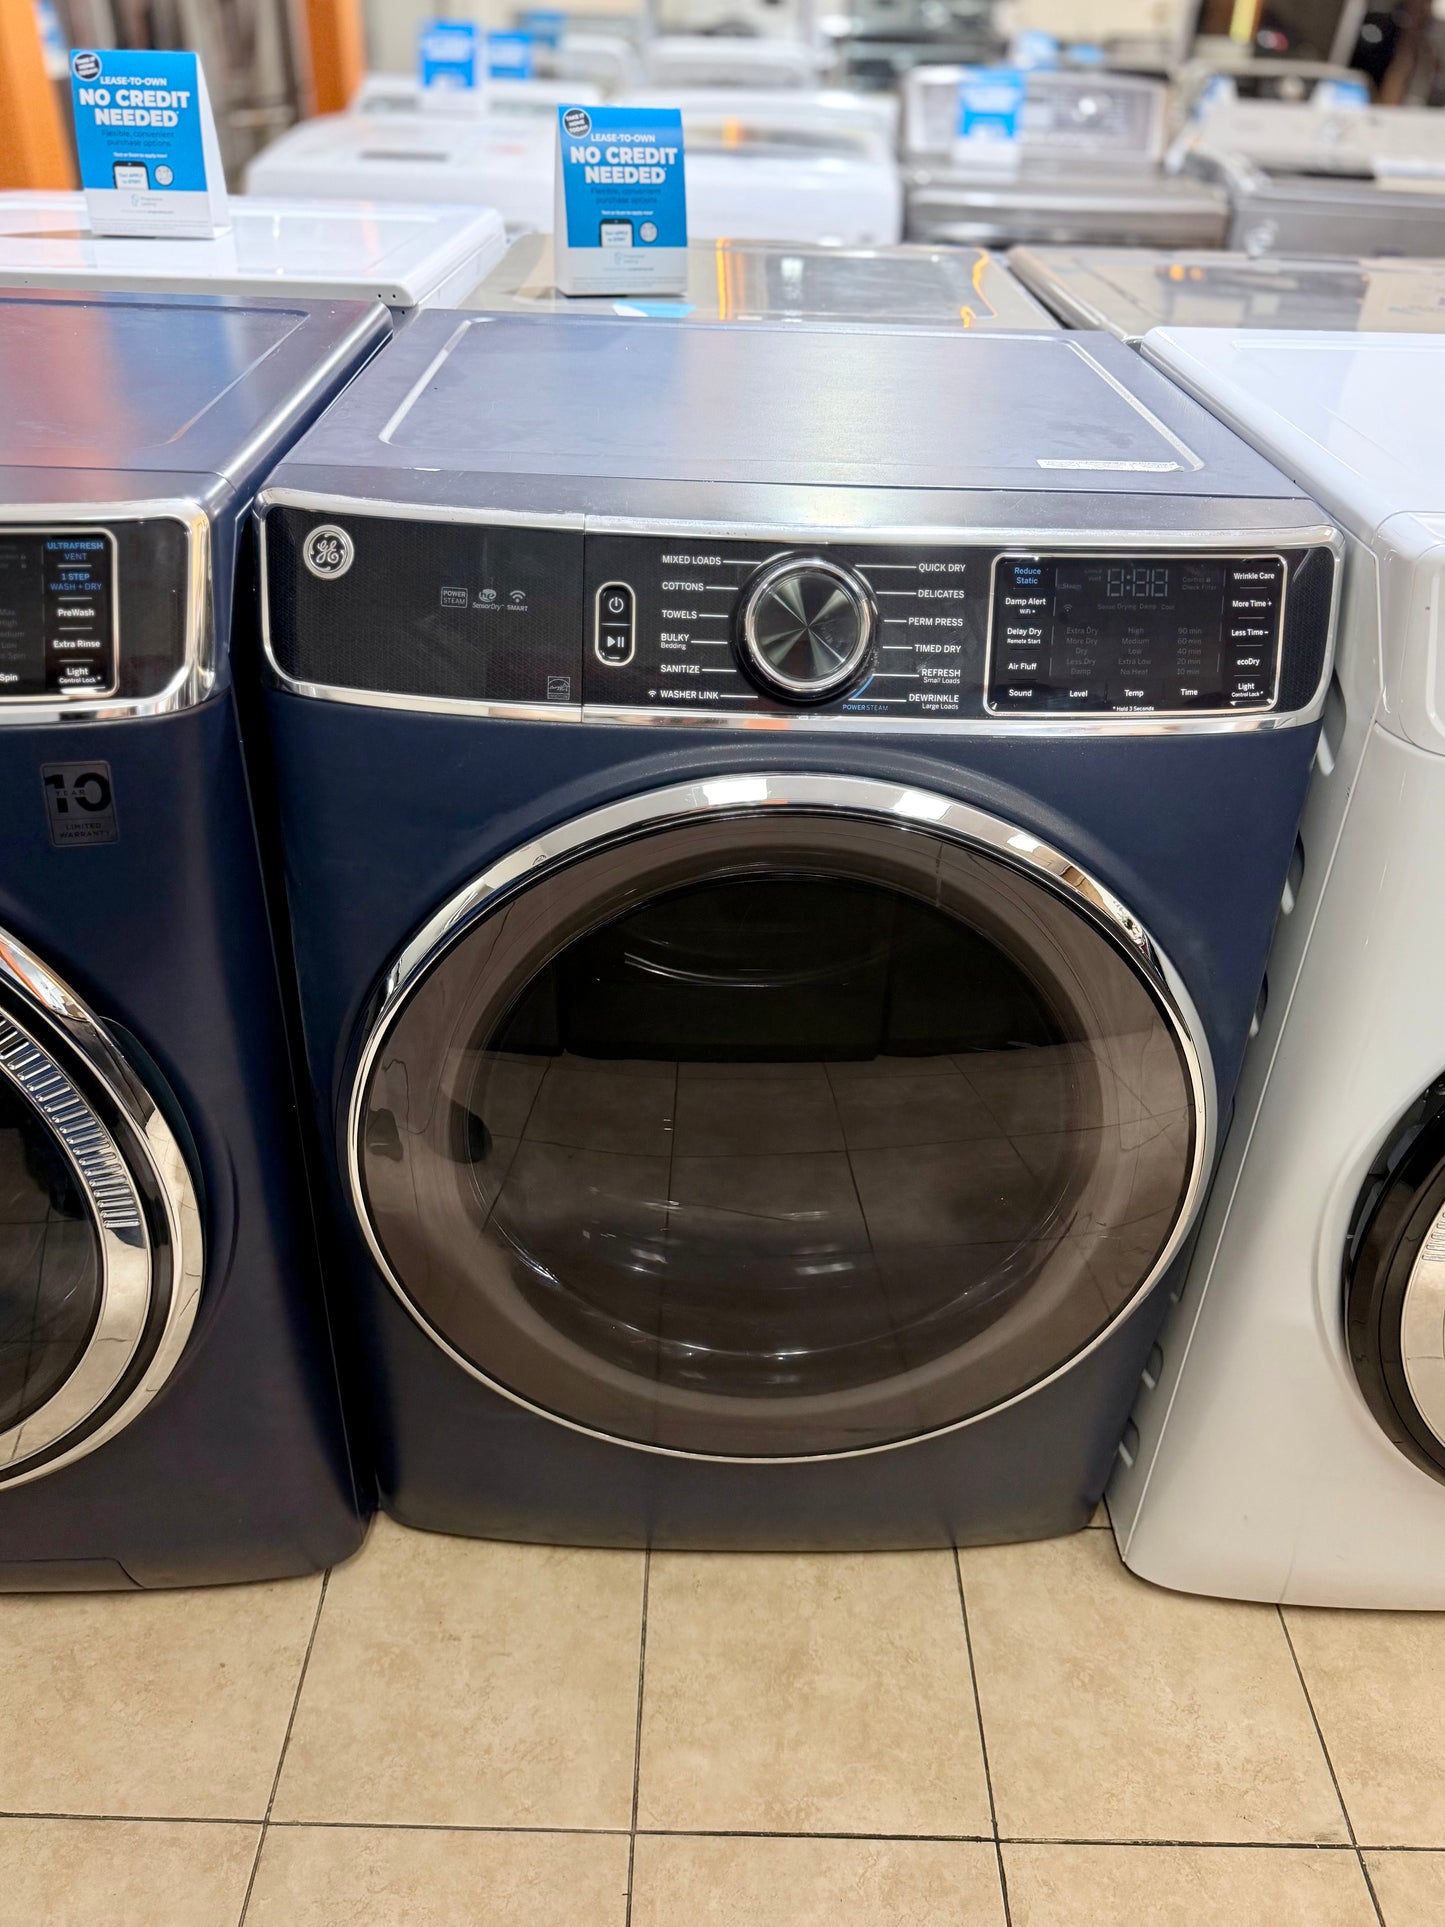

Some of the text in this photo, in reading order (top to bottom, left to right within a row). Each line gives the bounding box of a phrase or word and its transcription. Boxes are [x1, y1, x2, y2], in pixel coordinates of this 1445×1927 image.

[100, 76, 167, 86] LEASE-TO-OWN
[79, 88, 190, 108] NO CREDIT
[590, 134, 655, 142] LEASE-TO-OWN
[106, 139, 141, 147] purchase
[570, 146, 677, 164] NO CREDIT
[47, 542, 104, 550] ULTRAFRESH
[662, 555, 722, 565] MIXED LOADS
[918, 563, 966, 573] QUICK DRY
[1014, 567, 1041, 575] Reduce
[1233, 572, 1275, 580] Wrinkle Care
[1016, 577, 1038, 585] Static
[50, 583, 77, 591] WASH
[662, 582, 704, 591] COTTONS
[918, 589, 965, 598] DELICATES
[1005, 598, 1027, 606] Damp
[506, 604, 528, 612] SMART
[57, 609, 95, 617] PreWash
[662, 610, 697, 619] TOWELS
[908, 617, 963, 626] PERM PRESS
[1007, 628, 1042, 637] Delay Dry
[1086, 627, 1099, 635] Dry
[1128, 627, 1144, 635] High
[1231, 629, 1246, 637] Less
[660, 633, 690, 642] BULKY
[53, 640, 101, 648] Extra Rinse
[660, 642, 686, 650] Bedding
[1086, 638, 1098, 646] Dry
[914, 644, 961, 653] TIMED DRY
[1075, 648, 1088, 656] Dry
[1237, 659, 1260, 667] ecoDry
[66, 667, 88, 676] Light
[660, 664, 700, 673] SANITIZE
[1070, 668, 1092, 676] Damp
[921, 669, 961, 677] REFRESH
[0, 673, 18, 682] Spin
[1237, 683, 1255, 691] Light
[660, 690, 719, 699] WASHER LINK
[1009, 689, 1032, 697] Sound
[1069, 690, 1088, 698] Level
[1124, 689, 1144, 698] Temp
[1180, 688, 1198, 696] Time
[908, 694, 959, 703] DEWRINKLE
[922, 703, 940, 711] Large
[44, 772, 112, 813] 10
[59, 830, 110, 838] WARRANTY
